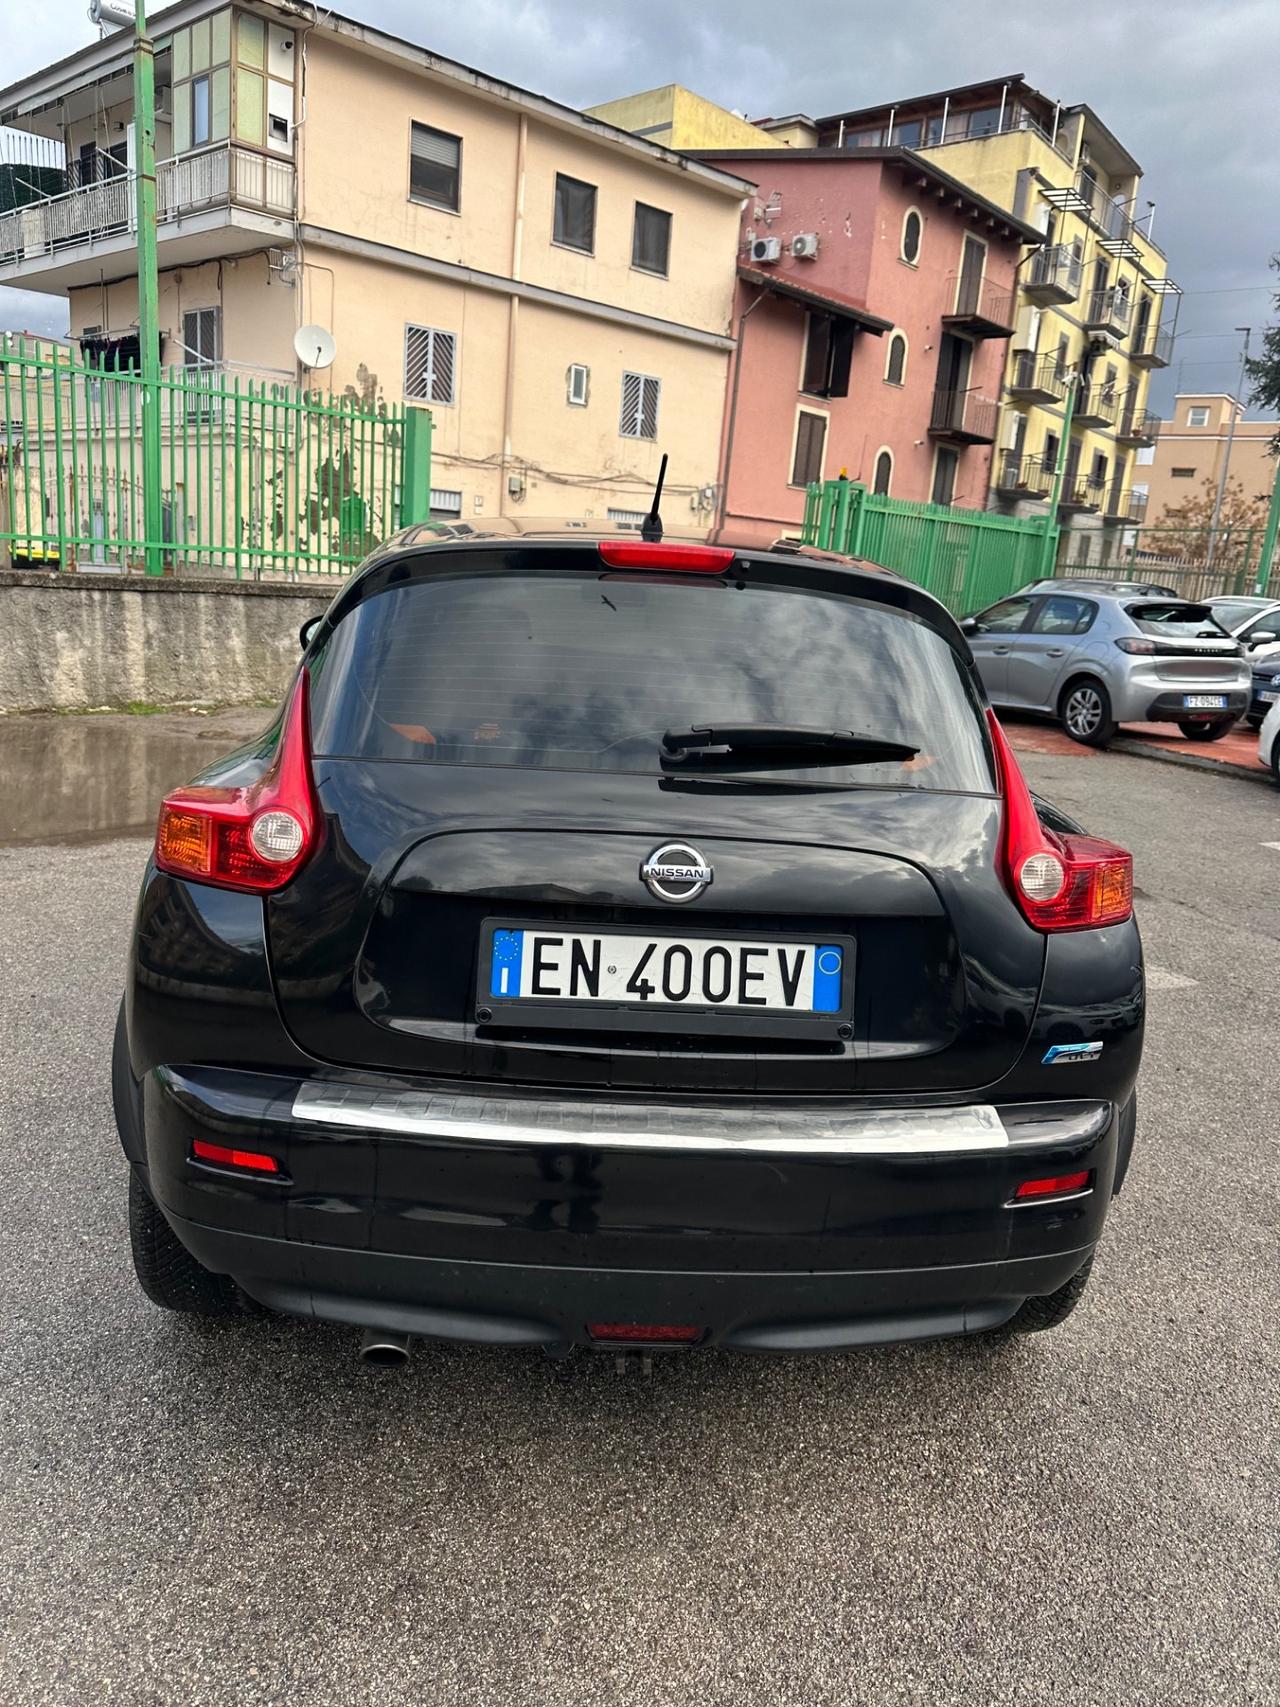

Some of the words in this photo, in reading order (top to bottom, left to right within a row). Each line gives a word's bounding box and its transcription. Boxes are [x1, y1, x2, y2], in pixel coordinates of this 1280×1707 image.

[651, 868, 704, 878] NISSAN
[531, 937, 600, 996] EN
[626, 943, 806, 1006] 400EV
